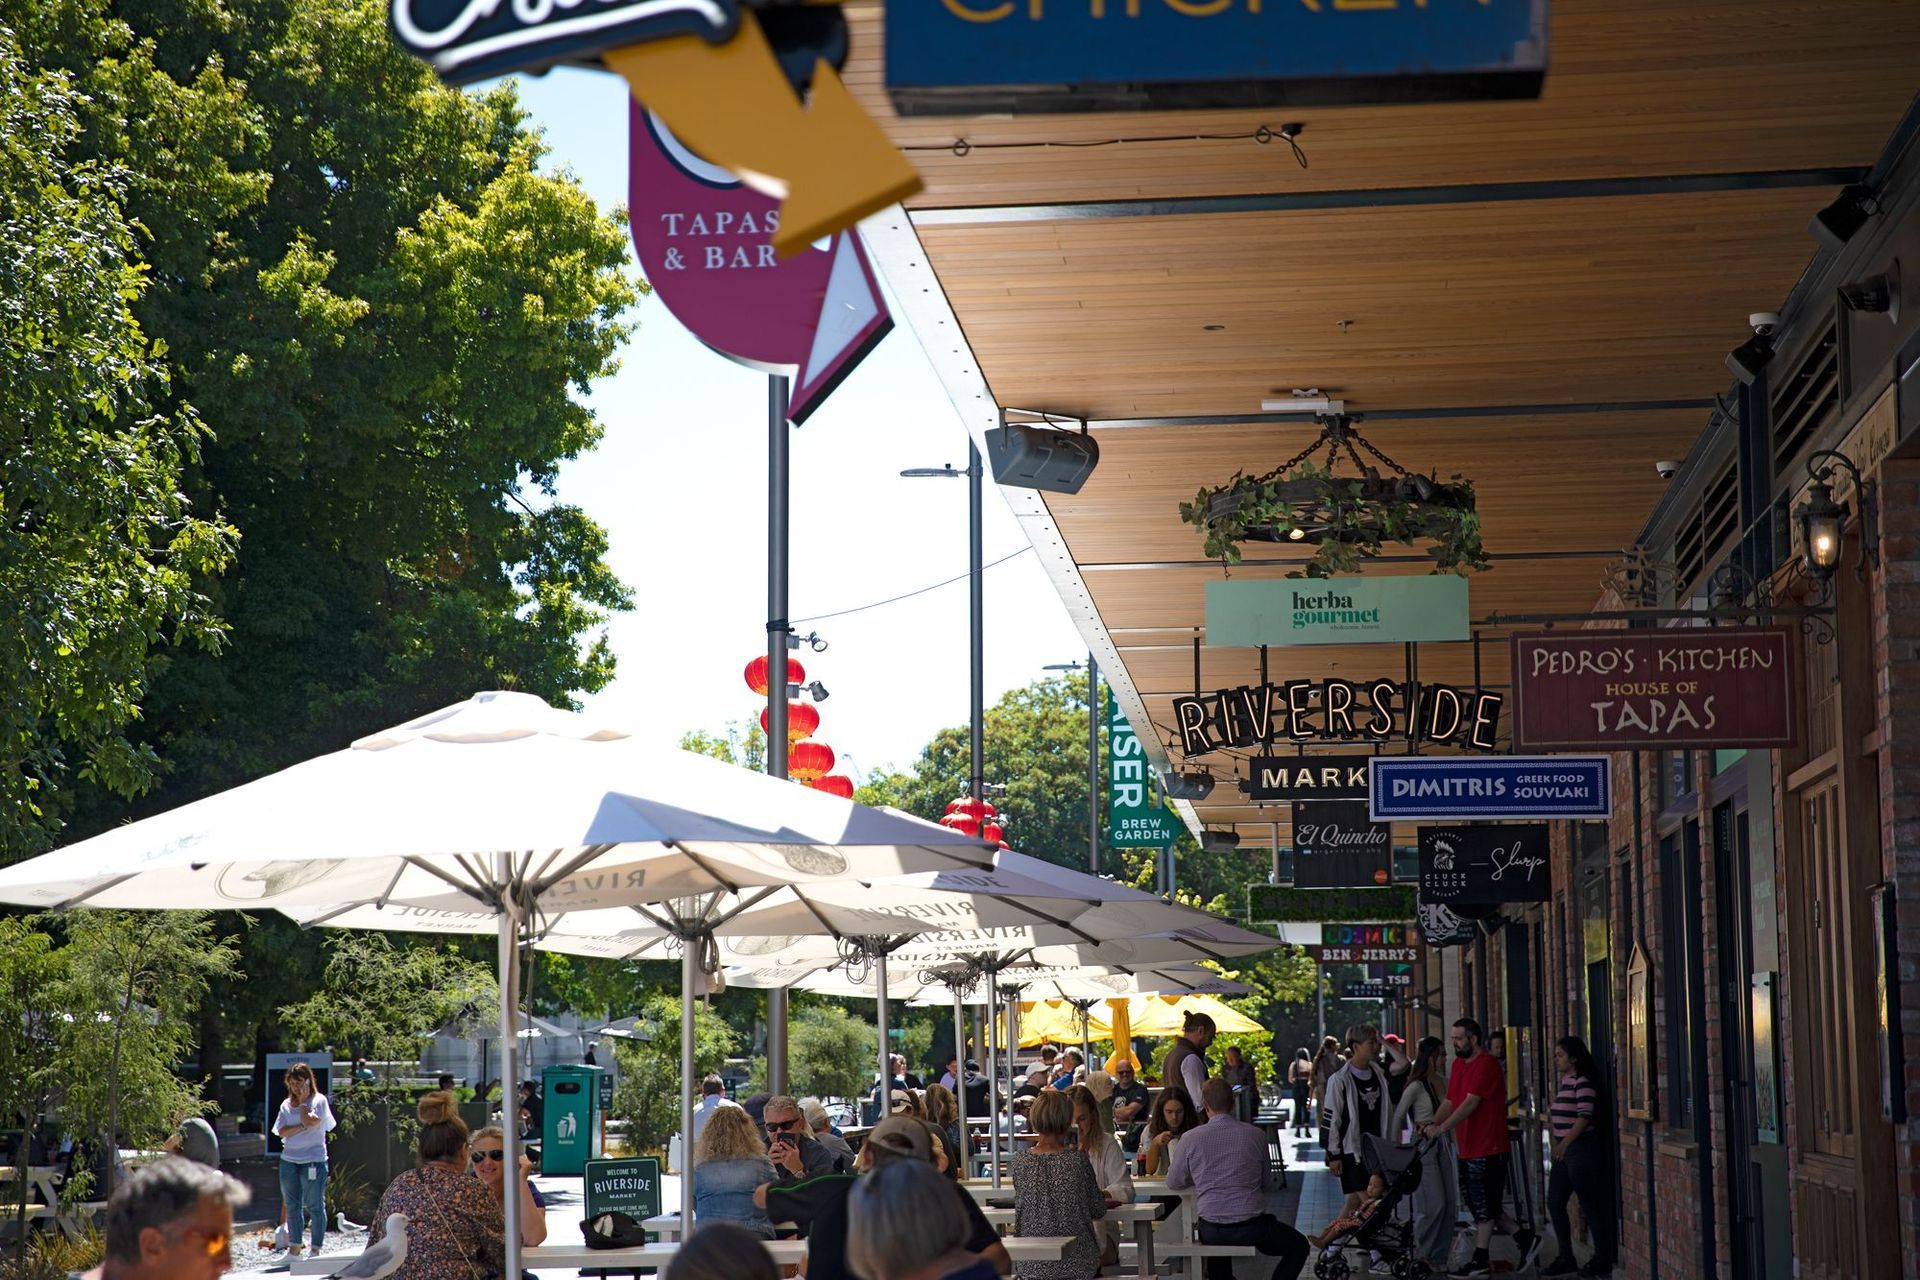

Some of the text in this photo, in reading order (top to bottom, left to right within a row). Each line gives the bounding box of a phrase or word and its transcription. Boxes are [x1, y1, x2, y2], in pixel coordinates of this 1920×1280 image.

[661, 209, 781, 237] TAPAS
[664, 244, 777, 270] & BAR
[1292, 590, 1353, 610] herba
[1292, 606, 1380, 629] gourmet
[1532, 646, 1773, 677] PEDRO'S KITCHEN
[1605, 681, 1699, 696] HOUSE OF
[1175, 680, 1502, 755] RIVERSIDE
[1590, 695, 1716, 734] TAPAS
[1112, 695, 1143, 809] AISER
[1261, 767, 1368, 789] MARK
[1392, 777, 1506, 798] DIMITRIS
[1516, 775, 1585, 784] GREEK FOOD
[1513, 787, 1589, 798] SOUVLAKI
[1114, 829, 1170, 840] GARDEN
[1121, 819, 1162, 829] BREW
[1296, 824, 1387, 847] El Quincho
[1490, 840, 1546, 882] Slurp
[1325, 927, 1402, 945] COSMIC
[1322, 948, 1351, 961] BEN
[1362, 947, 1417, 961] JERRY'S
[1387, 975, 1410, 984] TSB
[594, 1178, 651, 1194] RIVERSIDE
